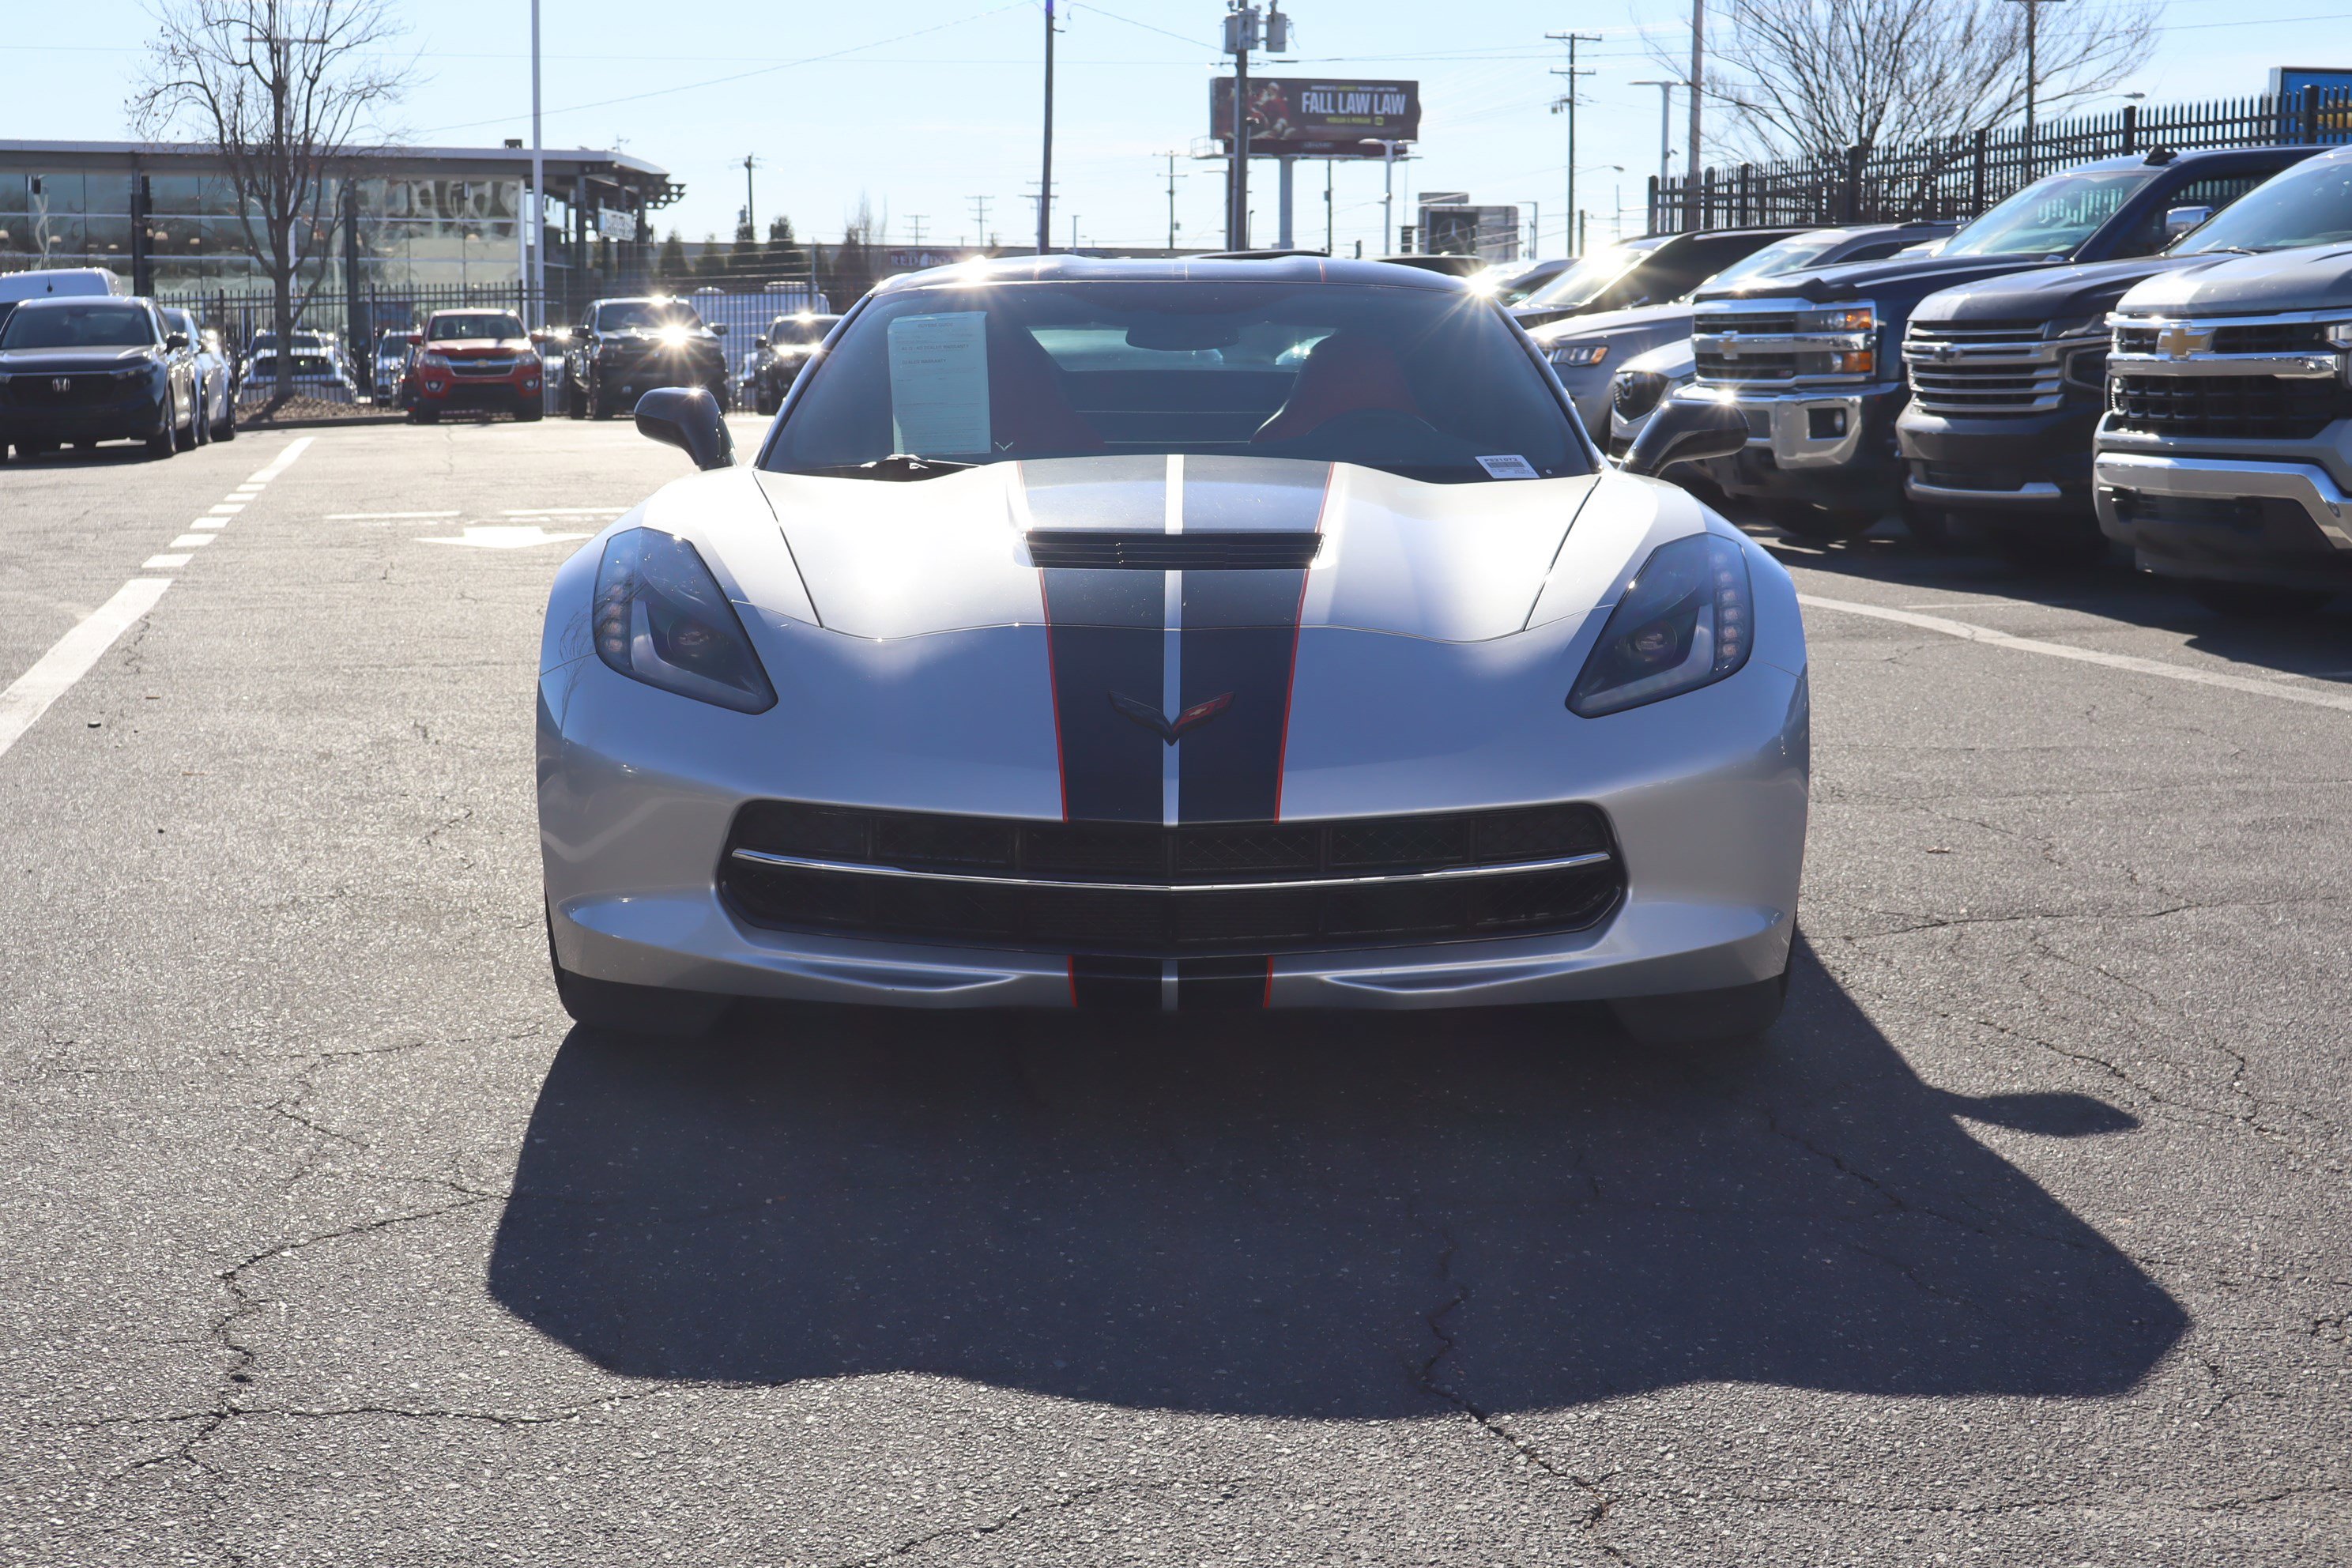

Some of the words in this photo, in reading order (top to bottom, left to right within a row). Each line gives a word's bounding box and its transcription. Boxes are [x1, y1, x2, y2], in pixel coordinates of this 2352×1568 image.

[1302, 92, 1335, 113] FALL
[1338, 92, 1371, 115] LAW
[1374, 93, 1406, 115] LAW
[891, 254, 919, 266] RED
